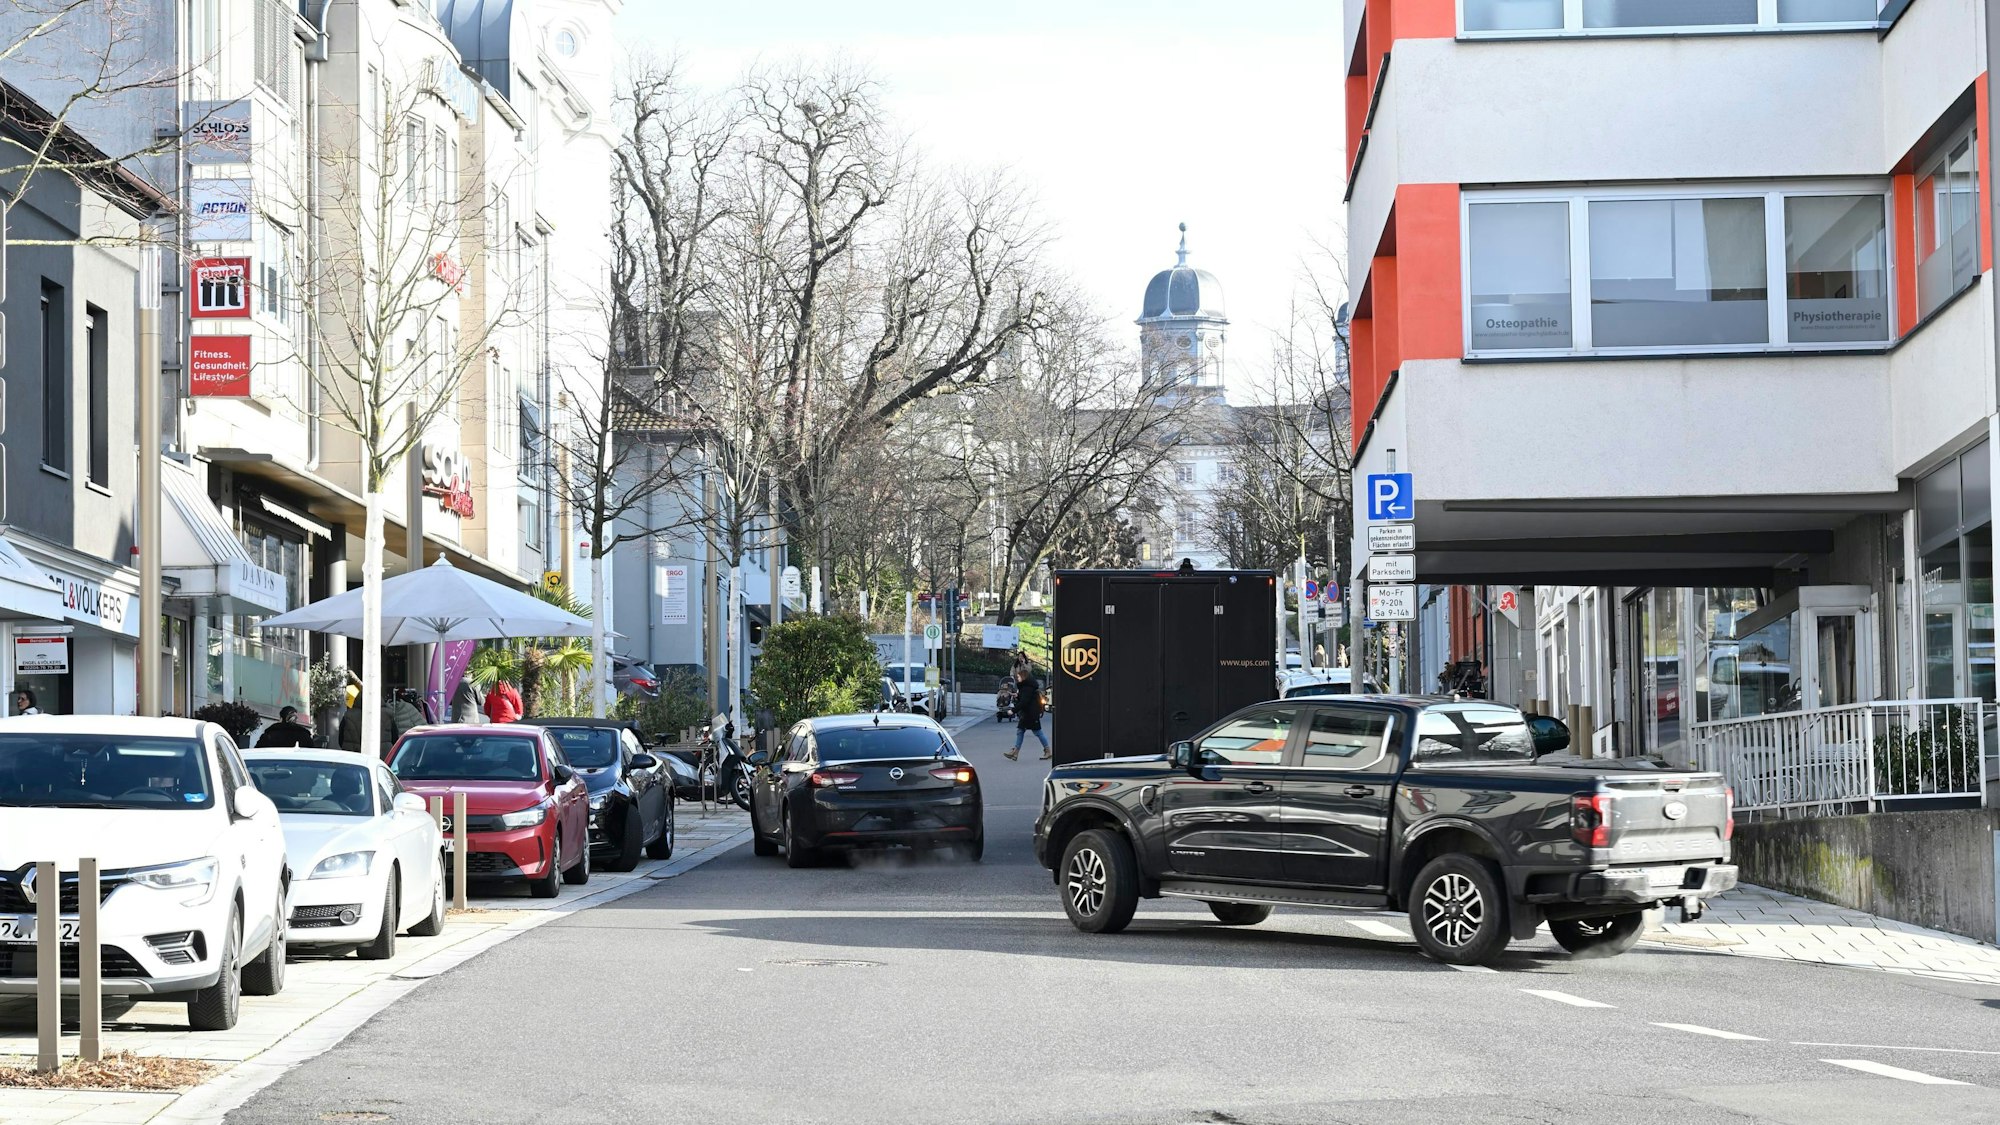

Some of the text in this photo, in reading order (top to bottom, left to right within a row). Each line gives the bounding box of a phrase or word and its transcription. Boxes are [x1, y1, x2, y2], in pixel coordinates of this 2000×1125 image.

[193, 122, 249, 133] SCHLOSS
[201, 202, 247, 213] ACTION
[201, 276, 241, 306] fit
[1793, 310, 1882, 324] Physiotherapie
[1486, 317, 1558, 330] Osteopathie
[193, 350, 232, 359] Fitness.
[193, 361, 249, 370] Gesundheit.
[193, 373, 237, 383] Lifestyle.
[1375, 479, 1399, 515] P
[1372, 568, 1411, 576] Parkschein
[1379, 589, 1404, 597] Mo-Fr
[1375, 609, 1409, 617] Sa 9-14h
[1064, 648, 1098, 673] ups
[1220, 659, 1270, 668] www.ups.com
